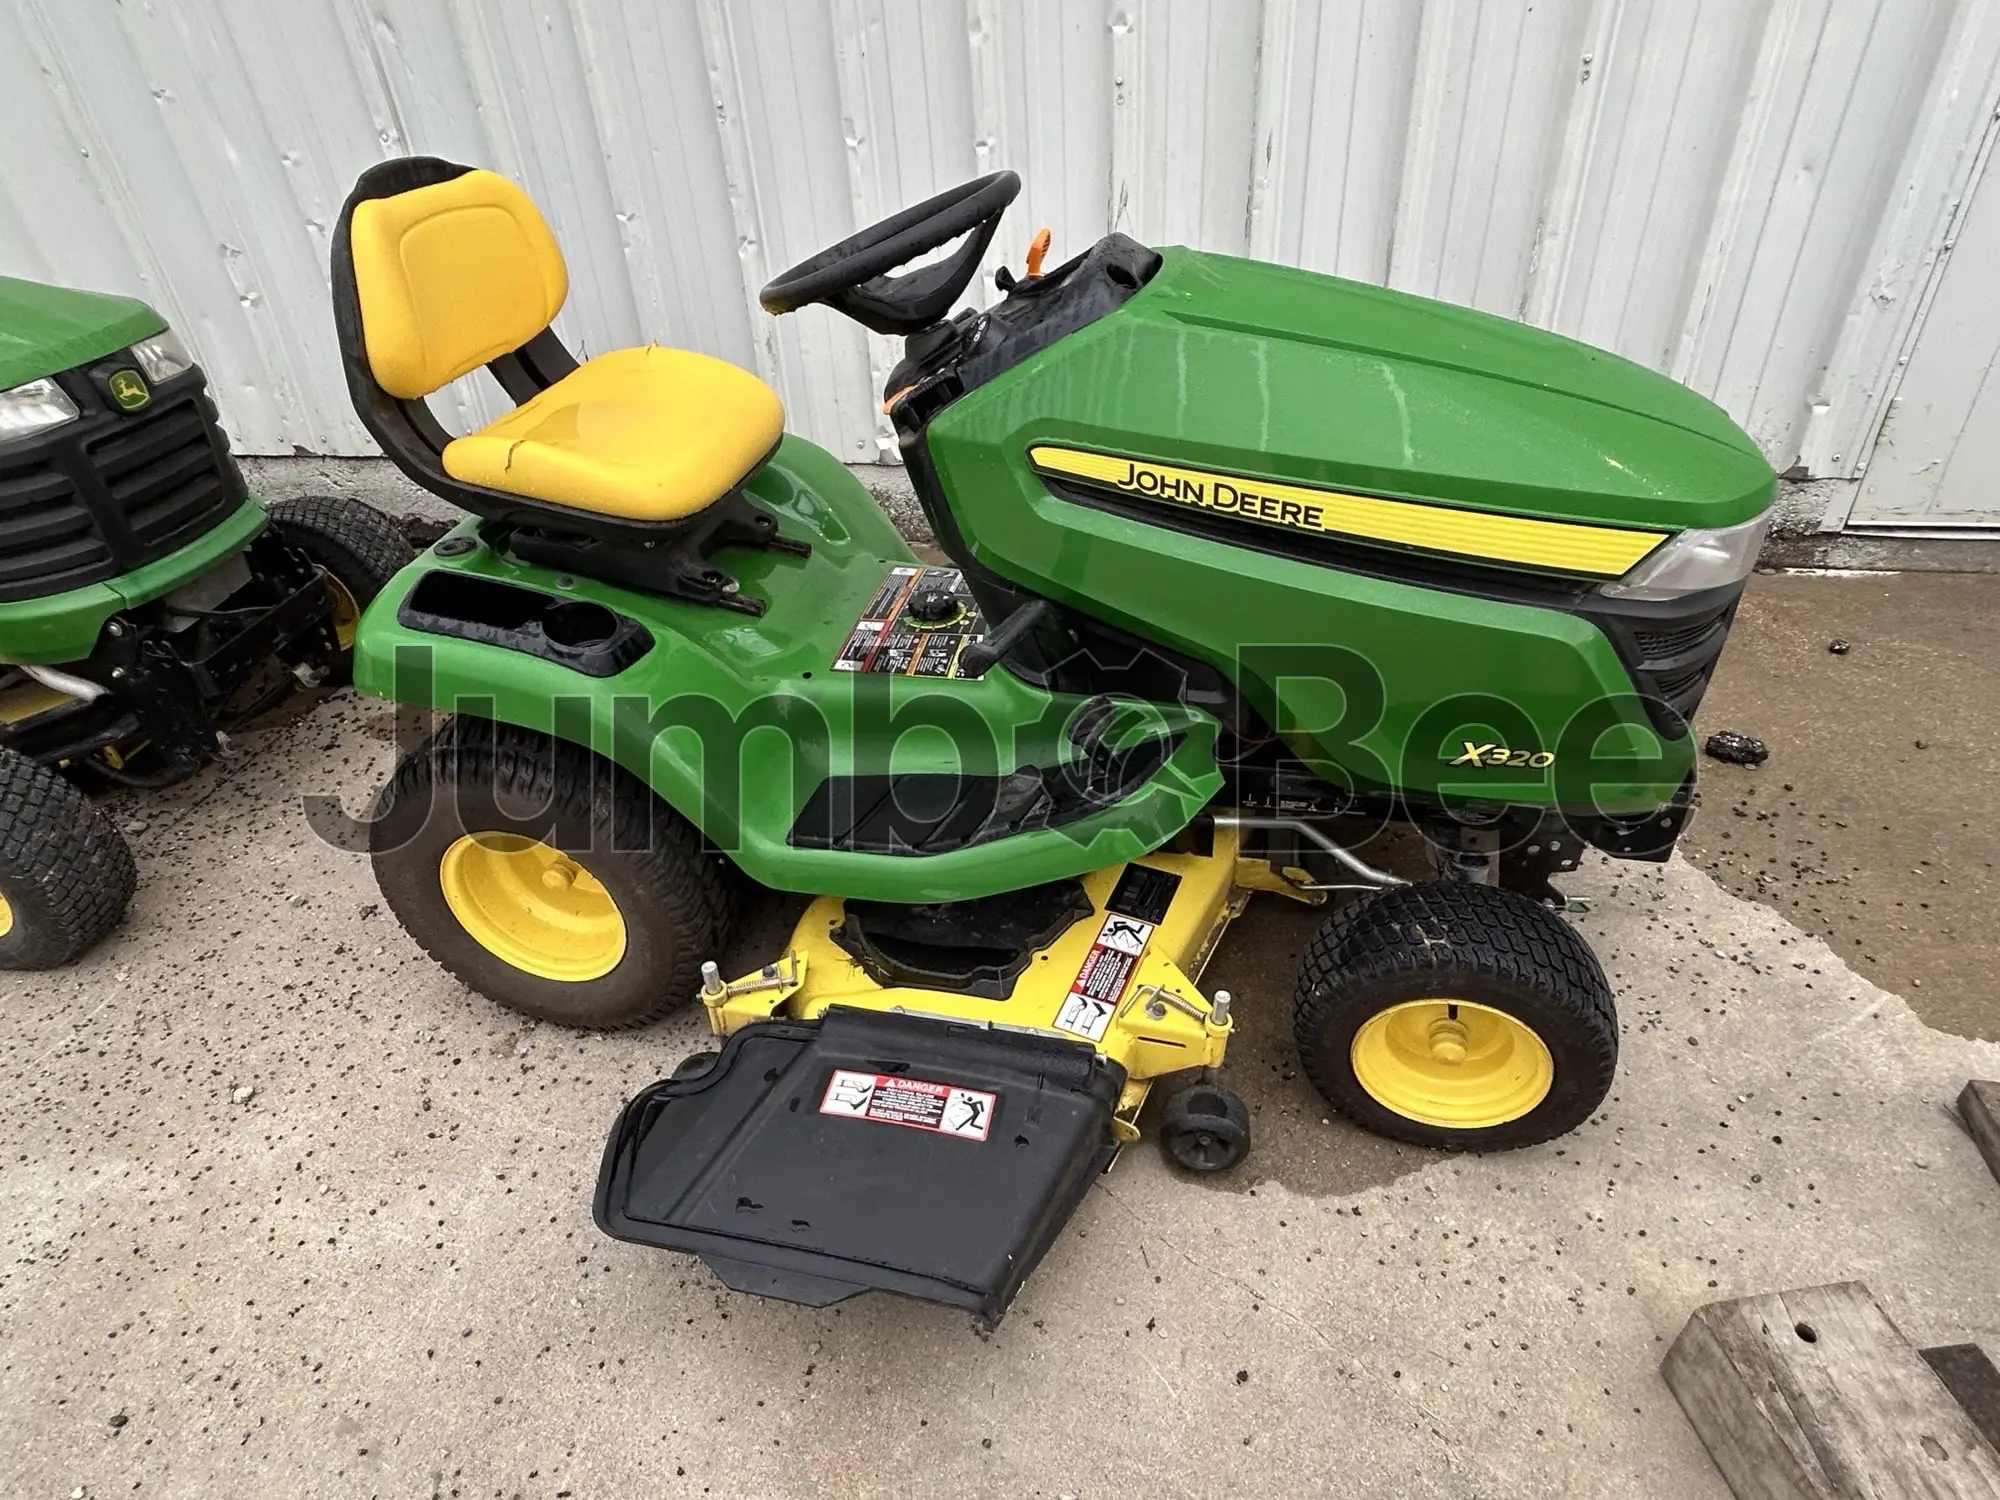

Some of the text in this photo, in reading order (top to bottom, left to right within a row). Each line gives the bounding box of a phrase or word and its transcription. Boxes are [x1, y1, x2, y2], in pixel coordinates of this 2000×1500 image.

[1117, 463, 1325, 527] JOHN DEERE
[1449, 741, 1555, 769] X320
[1079, 949, 1100, 979] DANGER
[897, 1080, 945, 1095] DANGER
